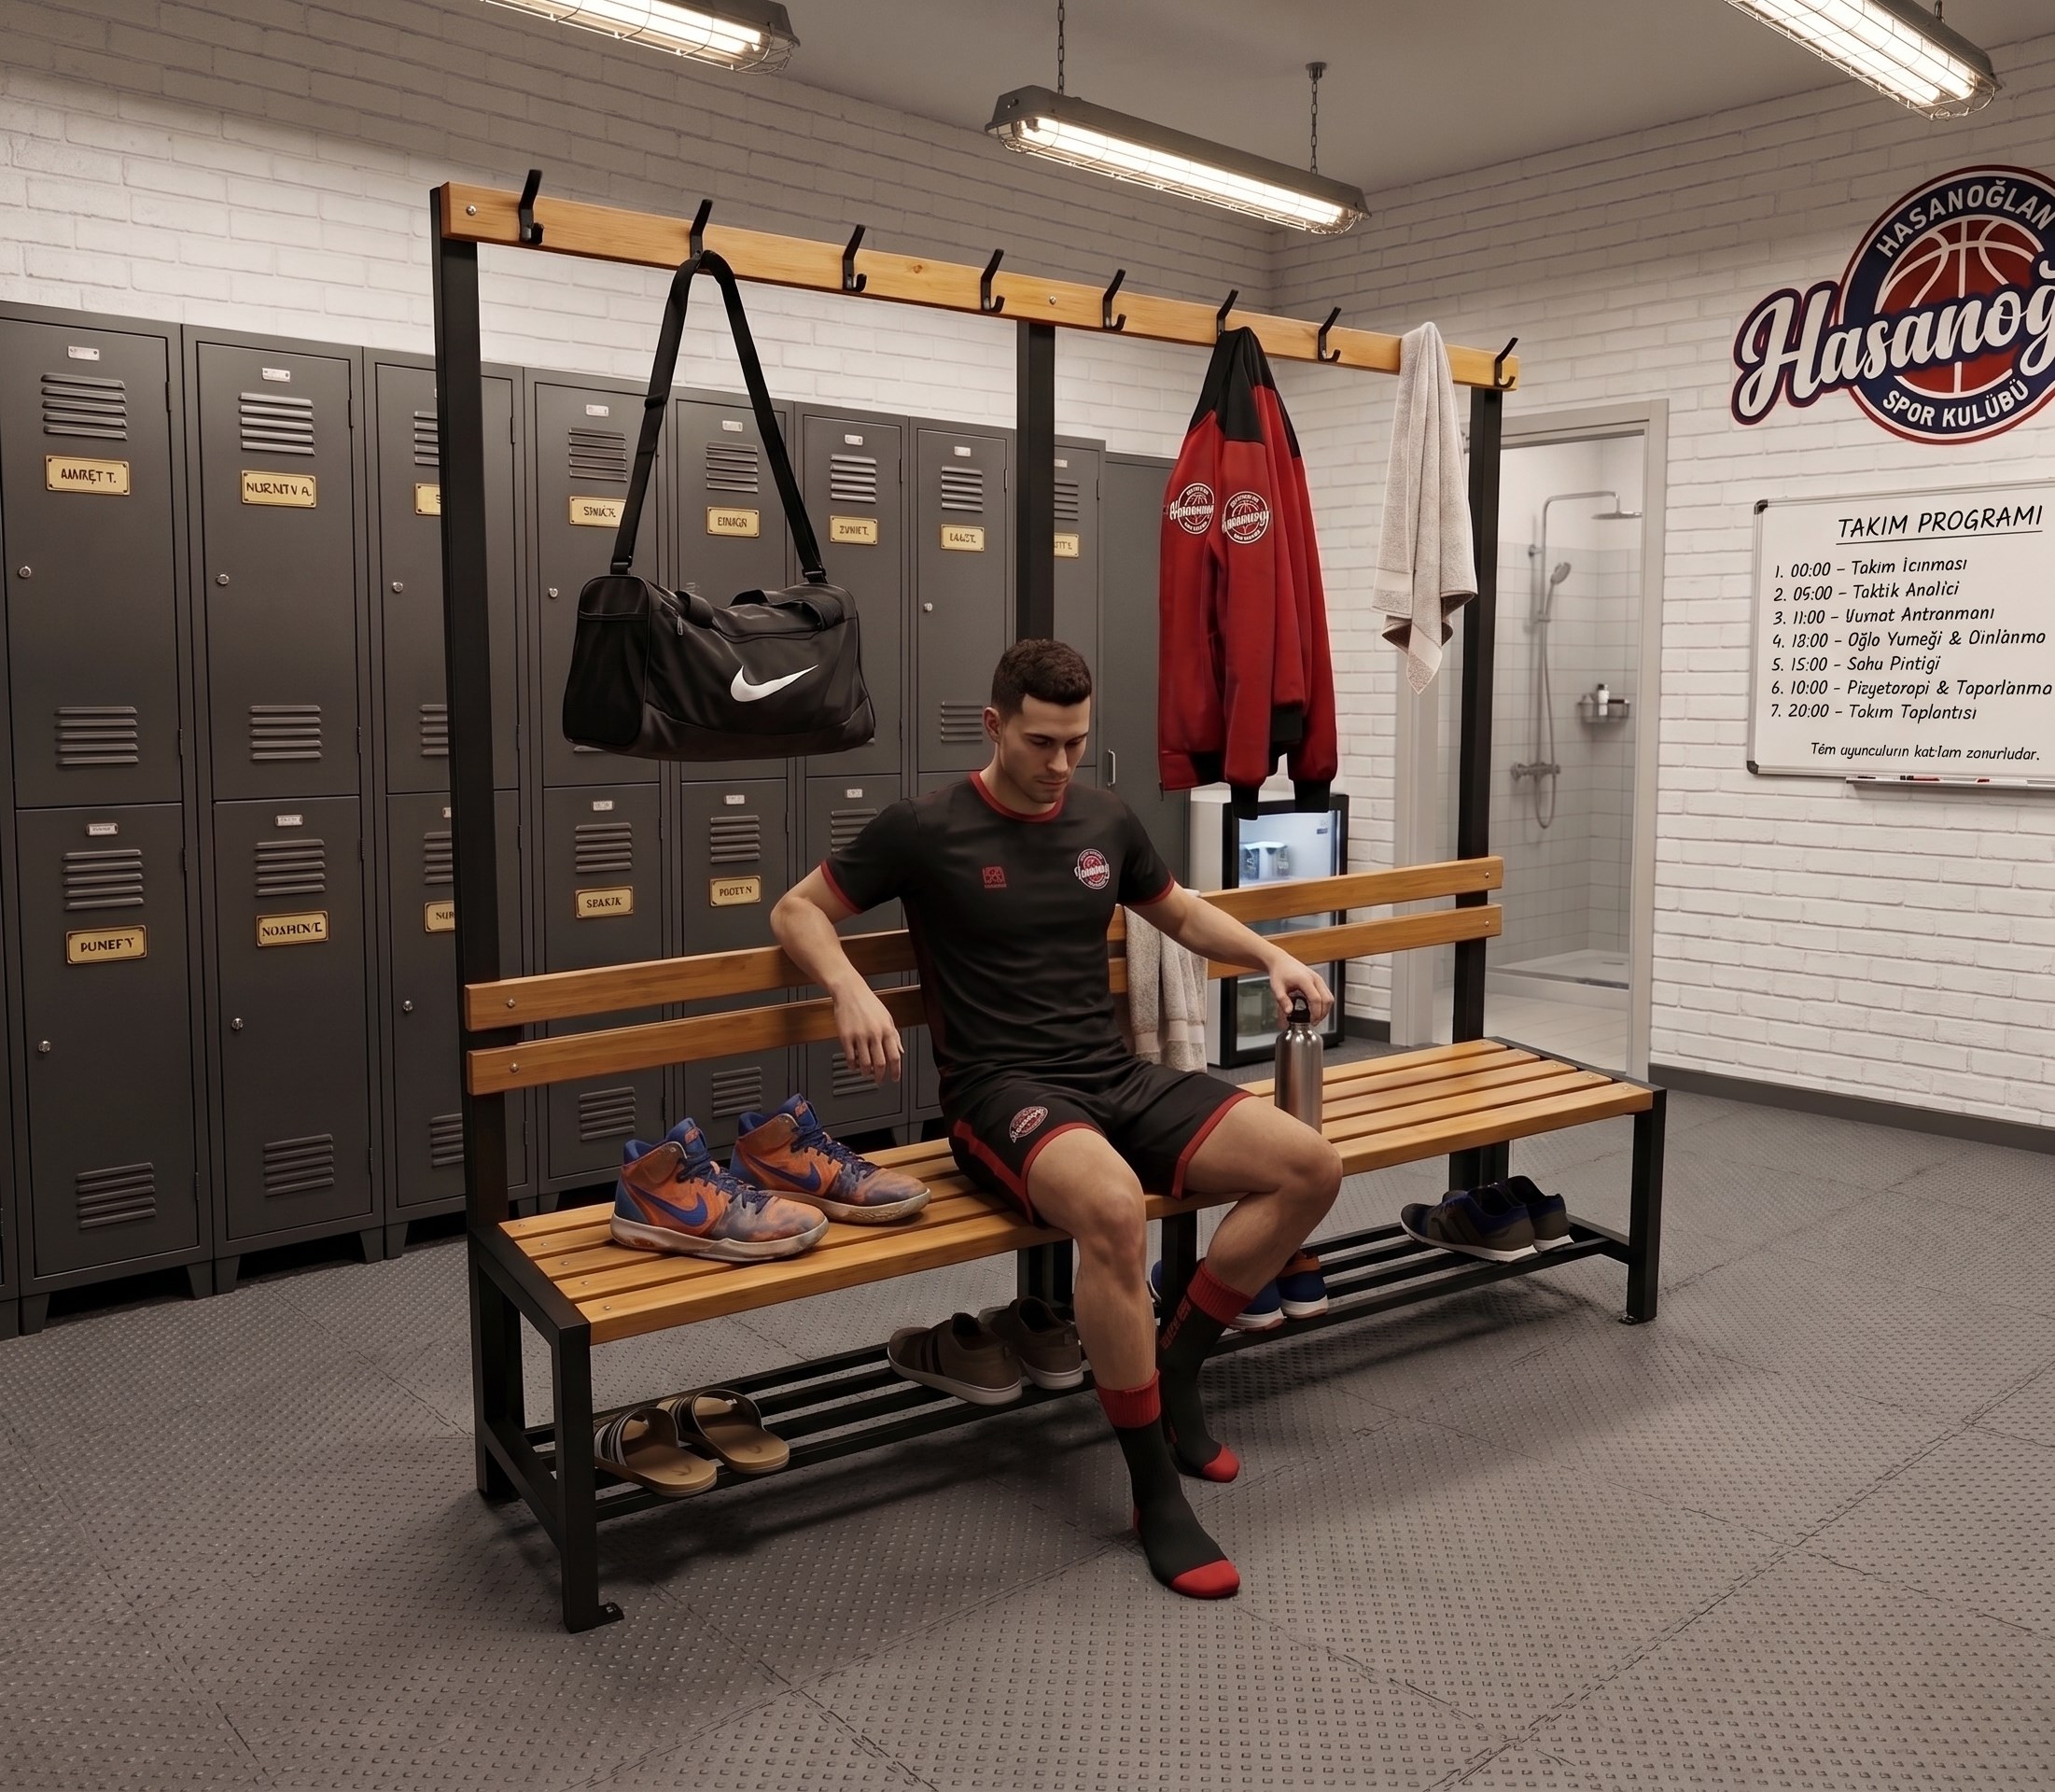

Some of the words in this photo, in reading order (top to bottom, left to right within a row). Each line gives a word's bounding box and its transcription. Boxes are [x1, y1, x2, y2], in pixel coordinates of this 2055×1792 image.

[1875, 179, 2055, 259] HASANOĞLAN
[1882, 389, 1936, 427] SPOR
[1941, 378, 2030, 428] KULÜBÜ
[1838, 514, 1908, 539] TAKIM
[1917, 504, 2044, 534] PROGRAMI
[1774, 565, 1783, 579] 1.
[1790, 561, 1832, 578] 00:00
[1773, 587, 1787, 602] 2.
[1793, 585, 1833, 602] 05:00
[1852, 581, 1900, 599] Taktik
[1772, 610, 1786, 625] 3.
[1793, 609, 1825, 625] 11:00
[1772, 634, 1785, 649] 4.
[1791, 632, 1829, 649] 18:00
[1948, 630, 1962, 646] &
[1771, 657, 1784, 672] 5.
[1791, 656, 1828, 672] 15:00
[1770, 679, 1784, 695] 6.
[1790, 679, 1828, 695] 10:00
[1936, 679, 1950, 695] &
[1770, 703, 1782, 718] 7.
[1787, 703, 1830, 719] 20:00
